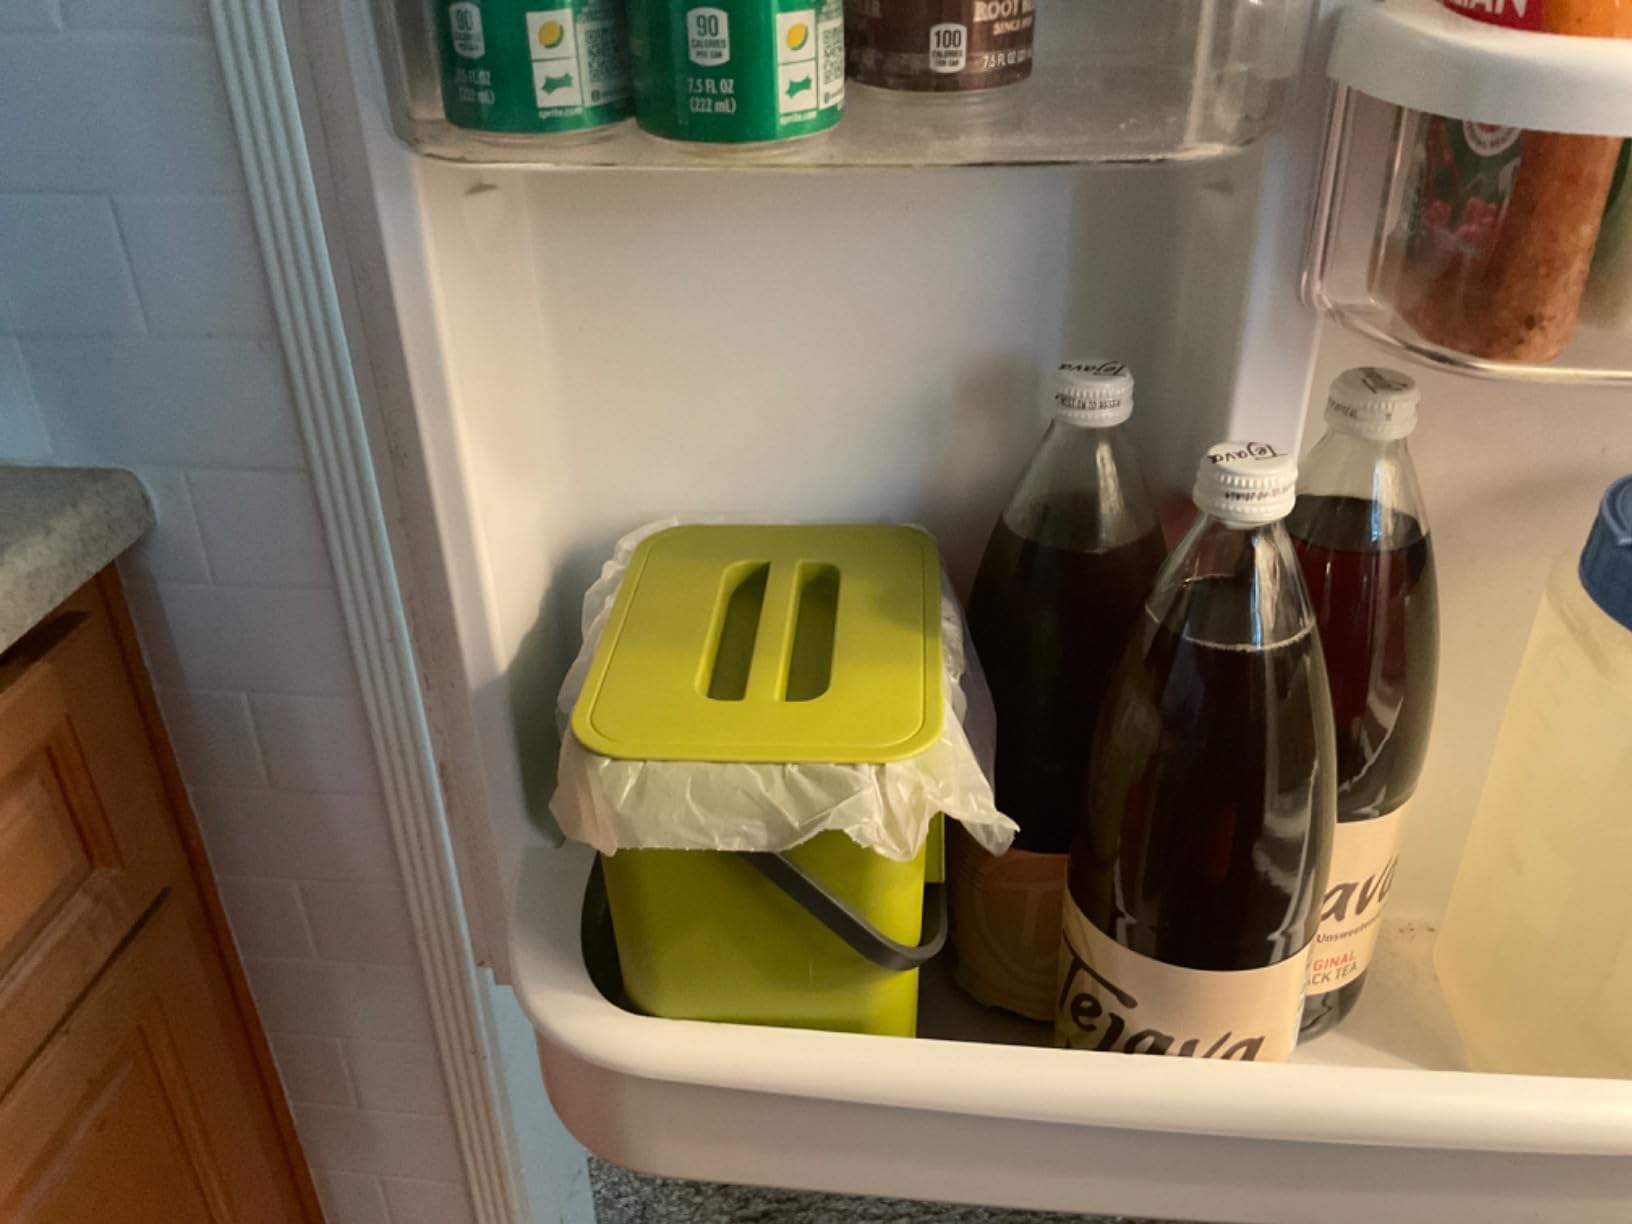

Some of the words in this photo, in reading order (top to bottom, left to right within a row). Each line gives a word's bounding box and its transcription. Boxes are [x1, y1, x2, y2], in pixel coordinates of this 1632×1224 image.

[695, 13, 719, 37] 90
[934, 29, 962, 49] 100
[687, 78, 703, 93] 7.5
[705, 79, 717, 94] FL
[719, 79, 735, 94] OZ
[689, 97, 713, 113] (222
[1207, 441, 1289, 465] Tejava
